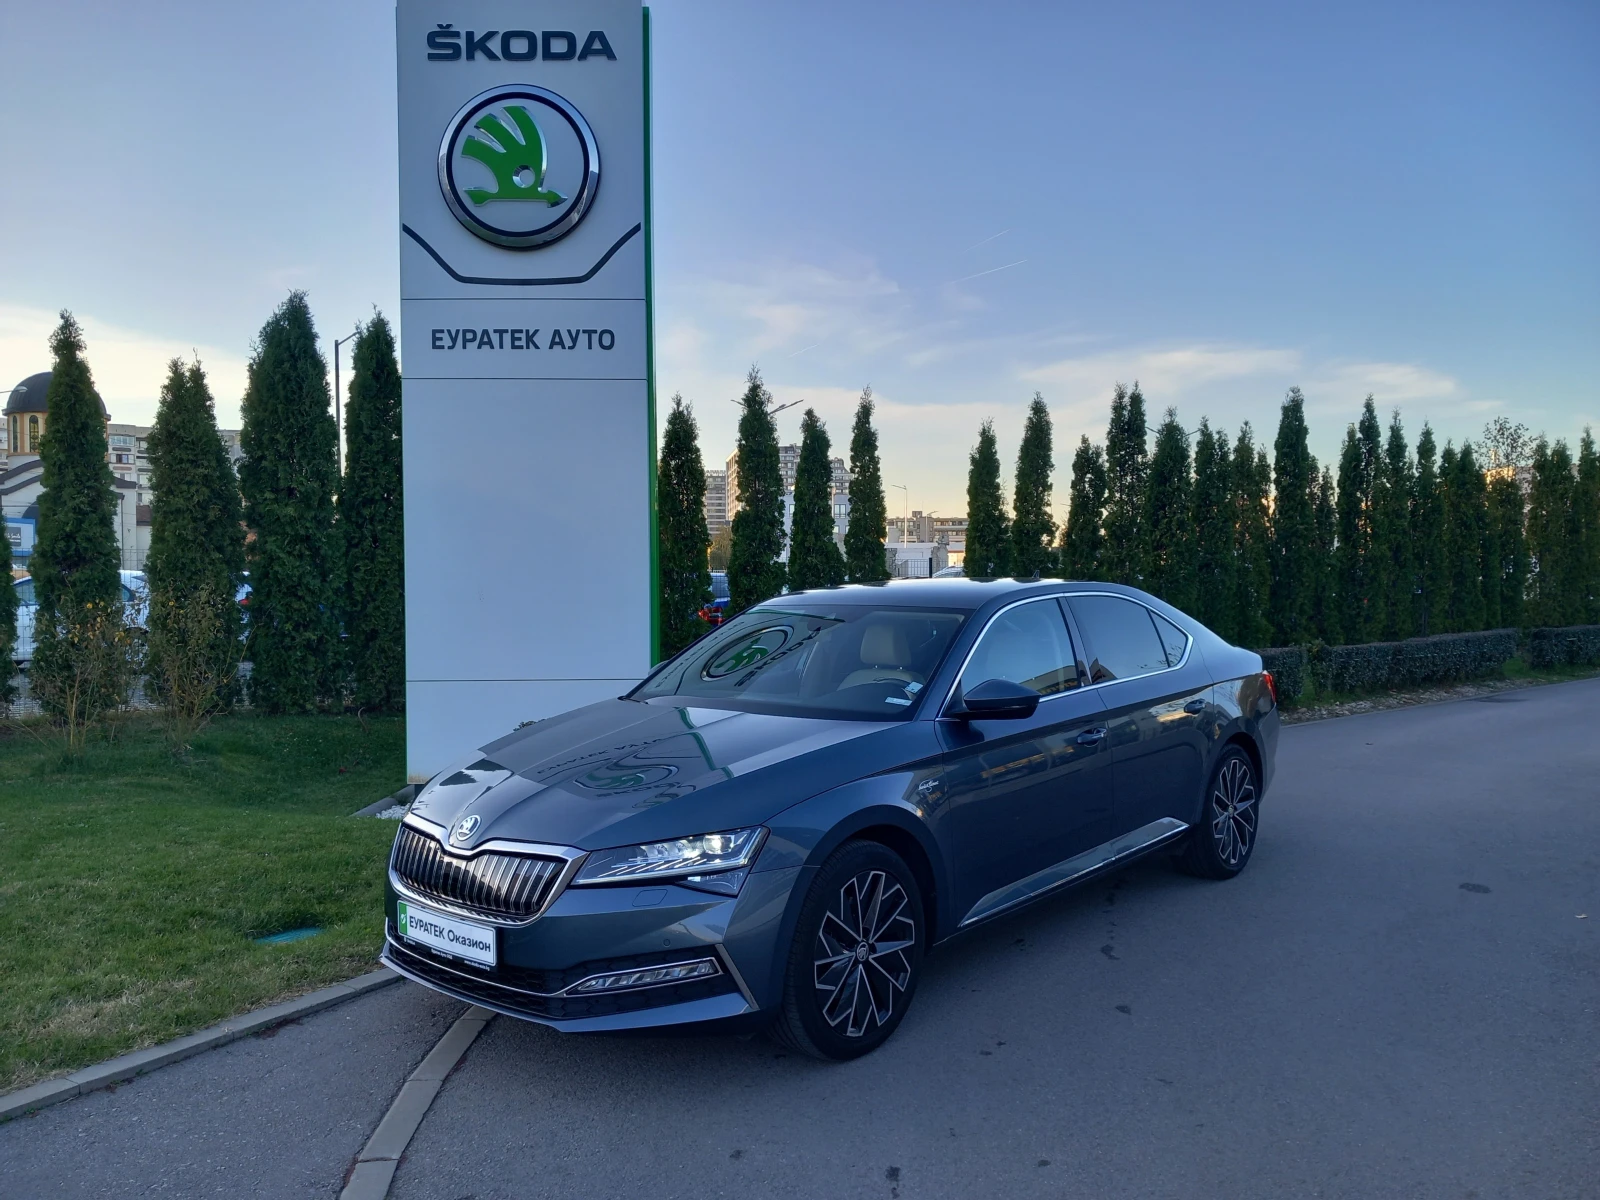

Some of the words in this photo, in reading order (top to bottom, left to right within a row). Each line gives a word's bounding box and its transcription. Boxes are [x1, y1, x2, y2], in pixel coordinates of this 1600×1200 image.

[426, 23, 618, 61] ŠKODA
[431, 328, 541, 350] ЕУРАТЕК
[548, 328, 615, 351] АУТО
[409, 915, 446, 940] ЕУРАТЕК
[447, 929, 491, 953] Оказион
